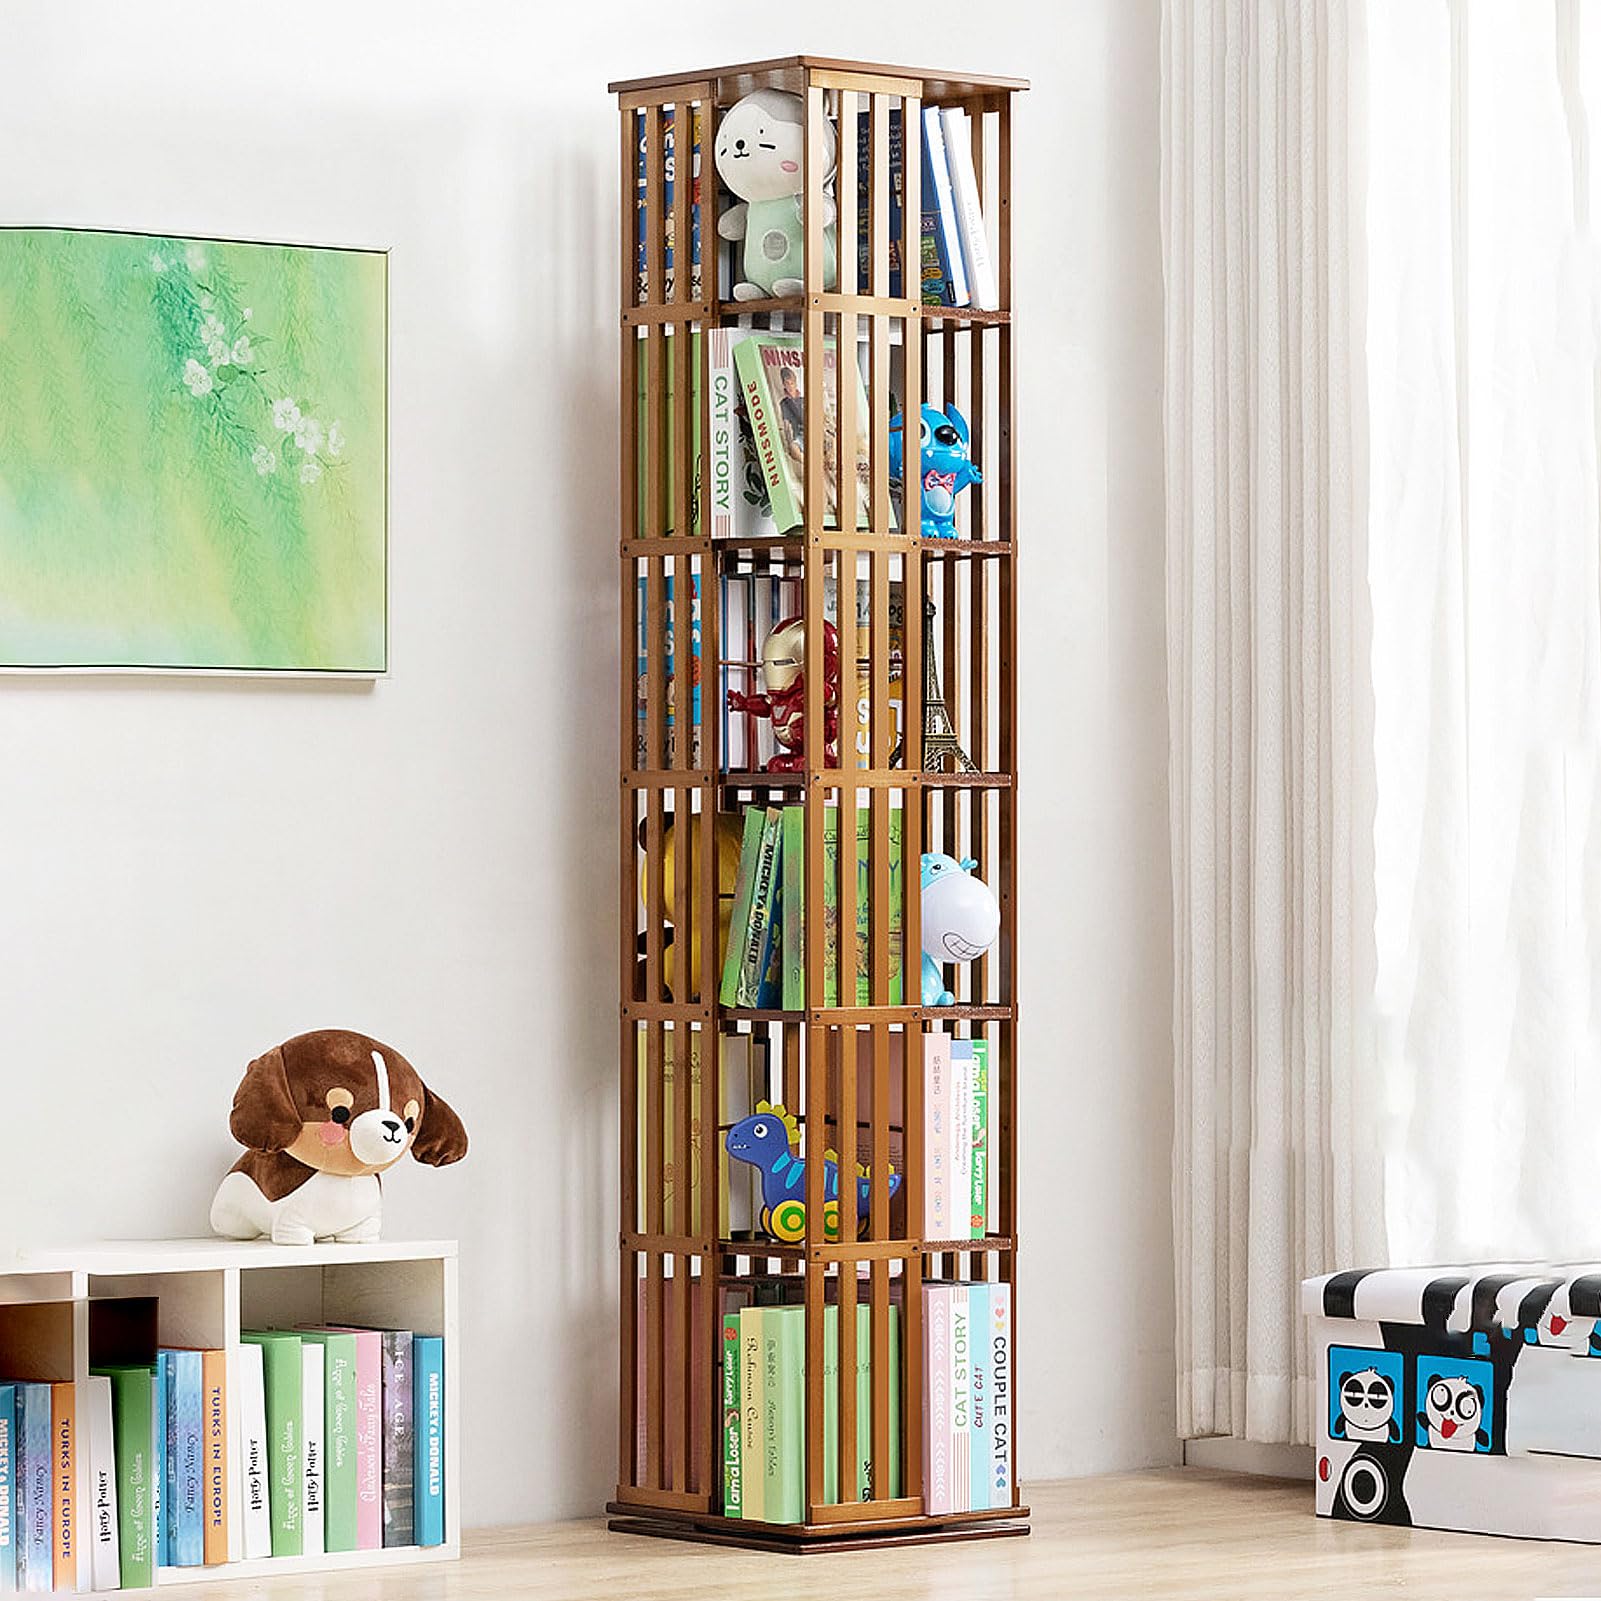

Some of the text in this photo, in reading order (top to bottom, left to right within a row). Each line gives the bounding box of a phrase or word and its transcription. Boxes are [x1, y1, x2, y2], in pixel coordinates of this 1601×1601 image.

[714, 375, 729, 509] CAT STORY
[747, 381, 779, 487] NINSMODE
[393, 1350, 404, 1437] ICE AGE
[429, 1373, 439, 1426] MICKEY
[954, 1313, 967, 1427] CAT STORY
[974, 1366, 983, 1428] CUTE CAT
[993, 1336, 1007, 1463] COUPLE CAT
[211, 1386, 222, 1527] TURKS IN EUROPE
[248, 1438, 262, 1511] Harry Potter
[305, 1440, 319, 1512] Harry Potter
[429, 1436, 440, 1497] DONALD
[725, 1427, 739, 1465] Loser
[730, 1466, 740, 1477] a
[61, 1418, 71, 1559] TURKS IN EUROPE
[97, 1470, 111, 1543] Harry Potter
[185, 1476, 198, 1513] Fancy
[730, 1479, 740, 1504] am
[33, 1507, 47, 1545] Fancy
